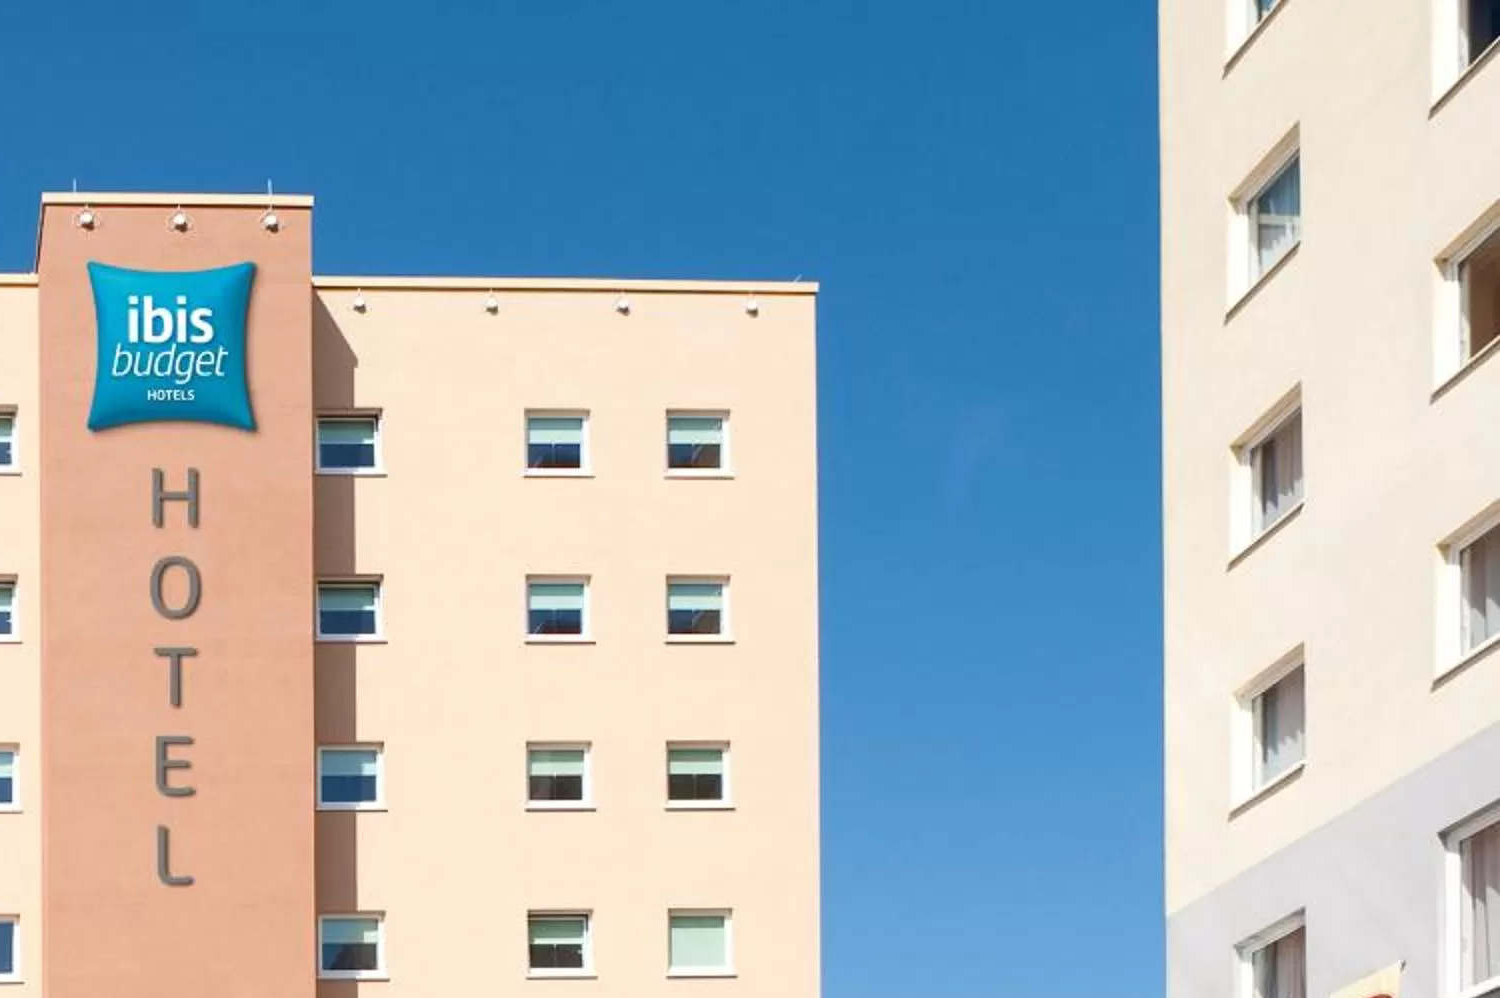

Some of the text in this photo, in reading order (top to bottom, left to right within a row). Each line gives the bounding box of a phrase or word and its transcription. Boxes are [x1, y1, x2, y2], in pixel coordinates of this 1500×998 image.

[128, 296, 214, 343] ibis
[111, 343, 229, 385] budget
[147, 390, 195, 401] HOTELS
[149, 467, 202, 887] HOTEL
